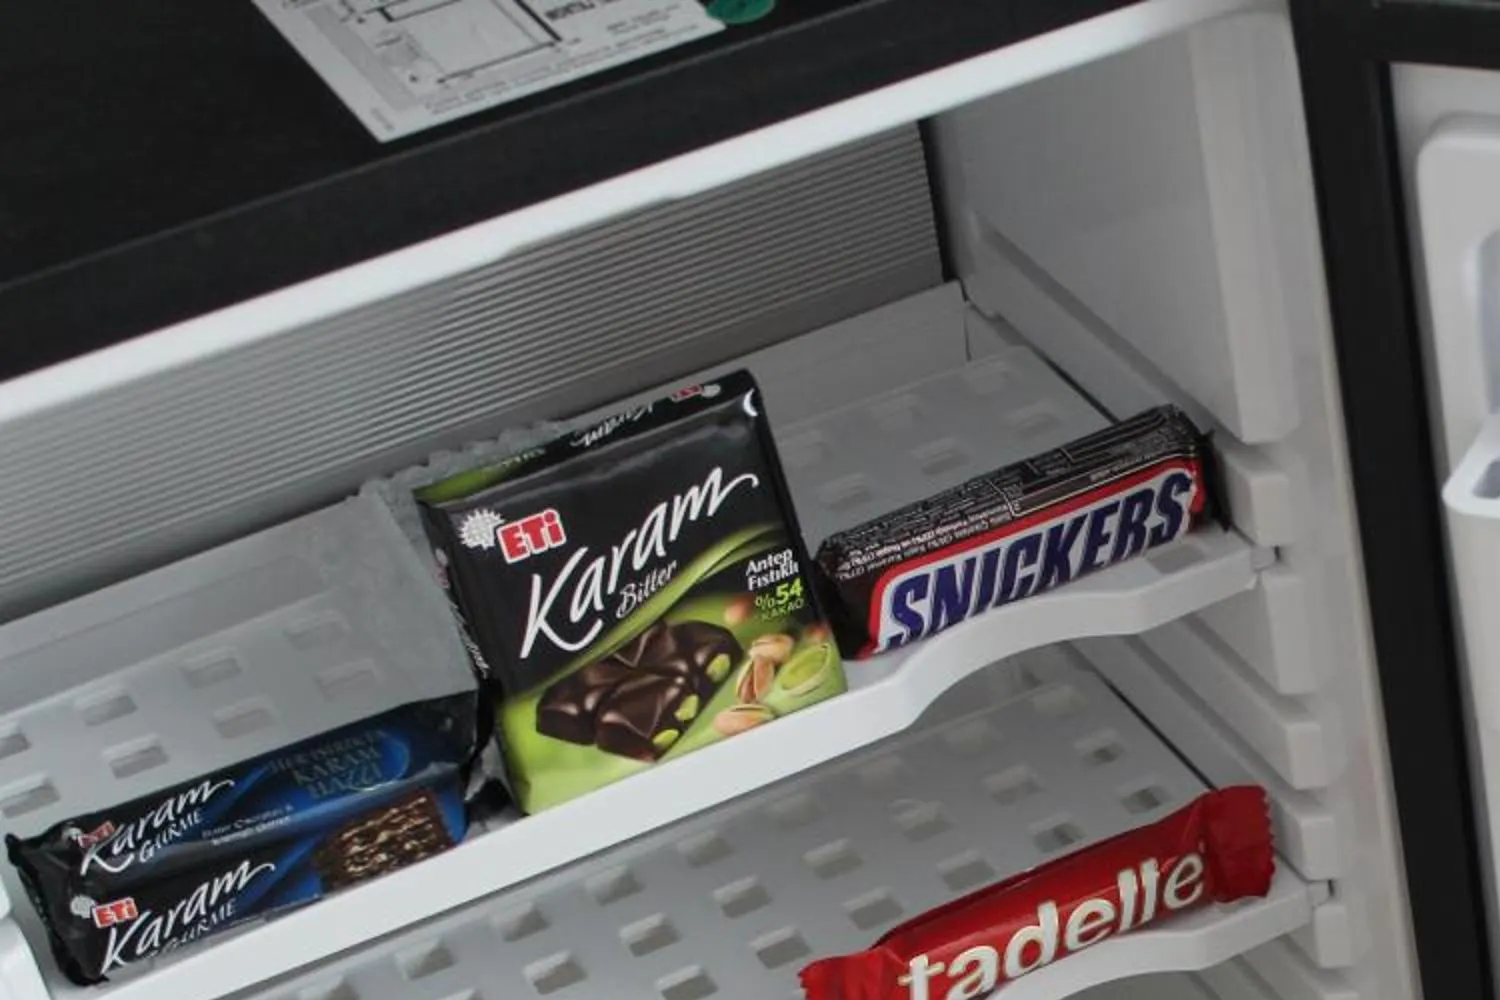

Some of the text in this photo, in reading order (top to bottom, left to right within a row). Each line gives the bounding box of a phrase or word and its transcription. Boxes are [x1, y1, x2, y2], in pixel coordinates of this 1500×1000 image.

[520, 467, 758, 658] Karam
[616, 560, 677, 617] Bitter
[746, 549, 793, 575] Antep
[884, 470, 1193, 652] SNICKERS
[81, 778, 234, 876] Karam
[101, 858, 276, 975] Karam
